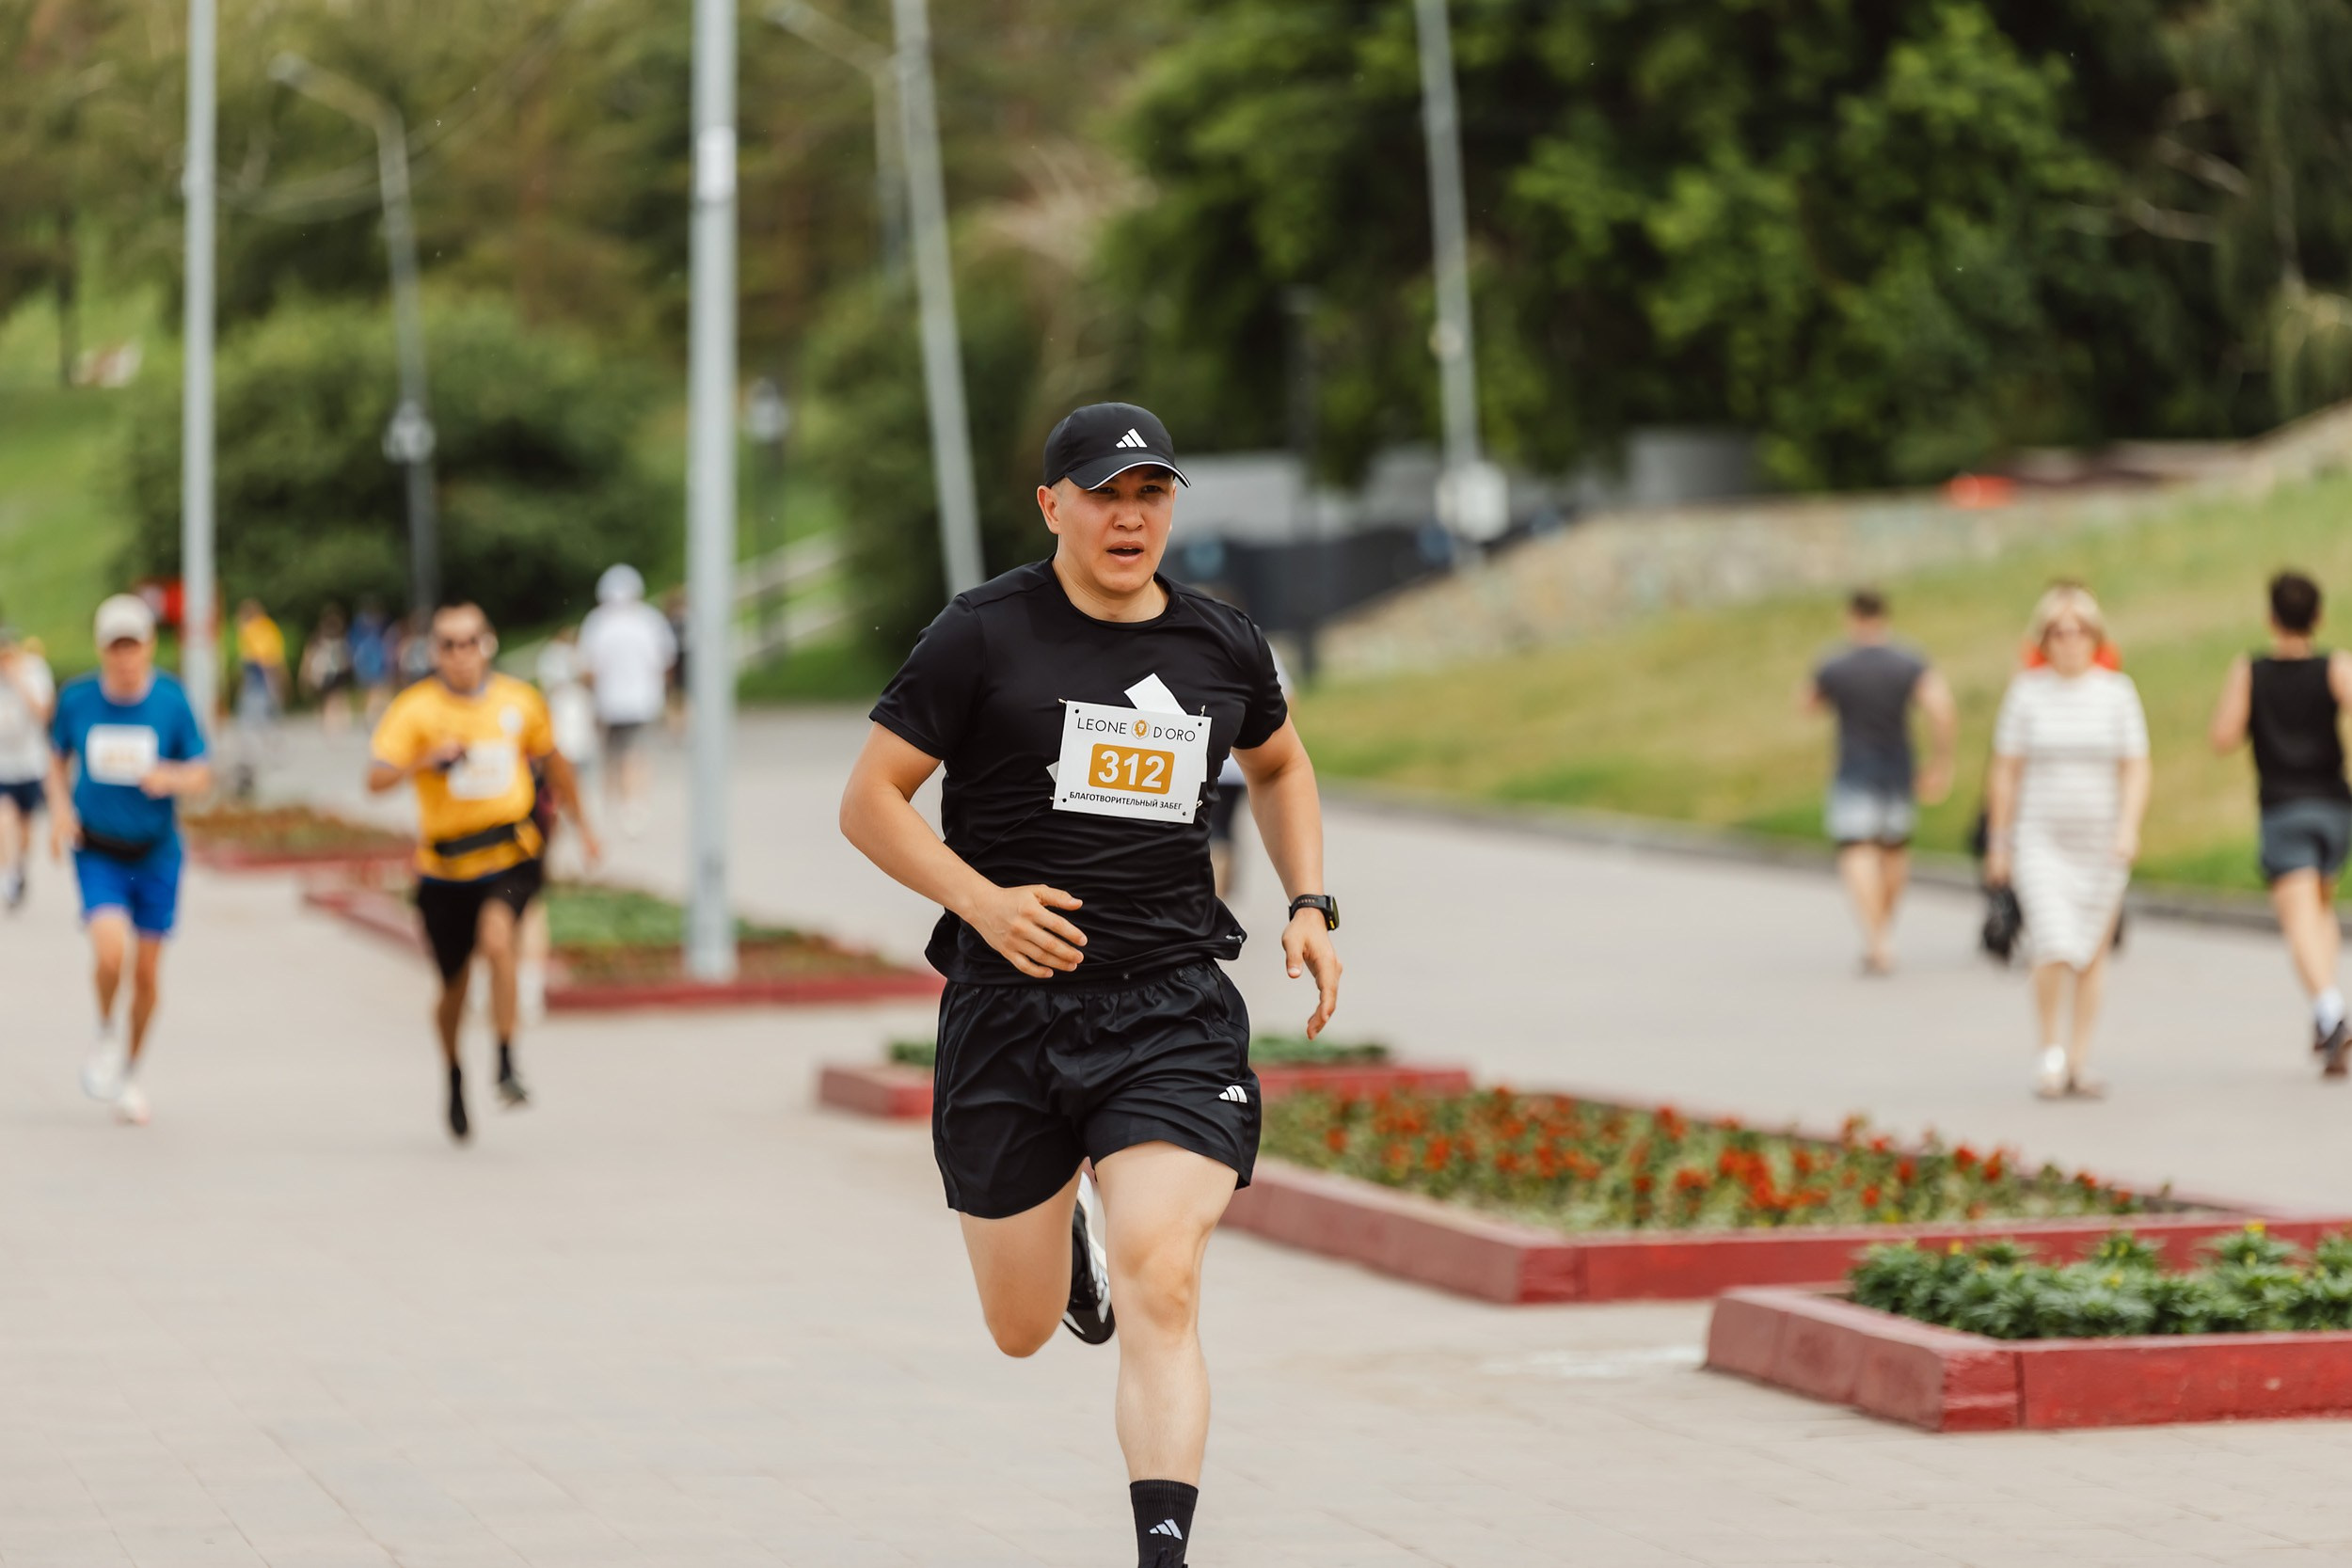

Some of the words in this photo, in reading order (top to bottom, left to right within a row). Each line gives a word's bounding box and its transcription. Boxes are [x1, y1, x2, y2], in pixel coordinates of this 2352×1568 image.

[1077, 718, 1127, 735] LEONE
[1153, 726, 1196, 742] D'ORO
[1098, 750, 1166, 788] 312
[1069, 791, 1158, 808] БЛАГОТВОРИТЕЛЬНЫЙ
[1159, 800, 1183, 810] ЗАБЕГ
